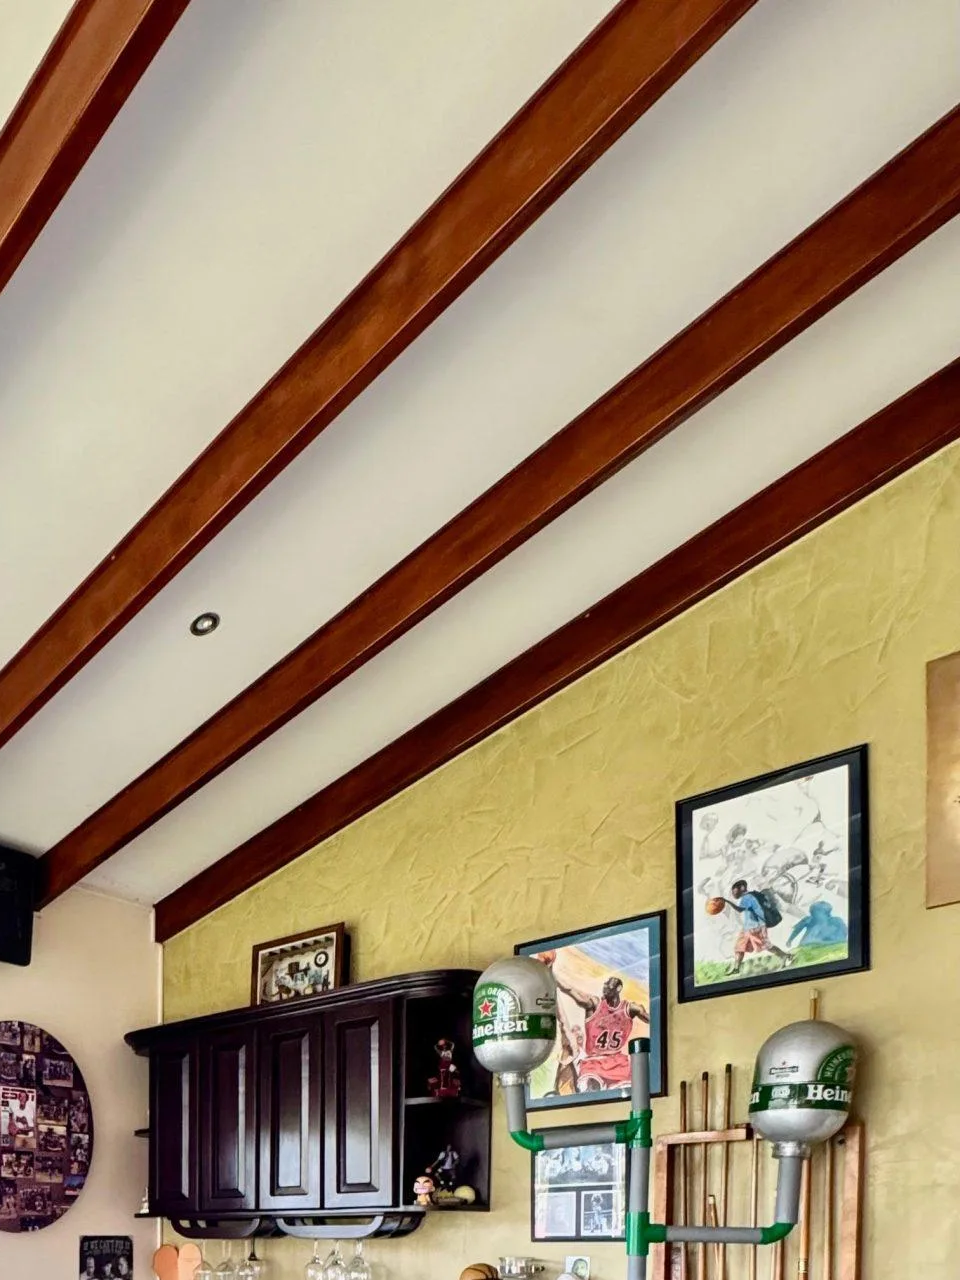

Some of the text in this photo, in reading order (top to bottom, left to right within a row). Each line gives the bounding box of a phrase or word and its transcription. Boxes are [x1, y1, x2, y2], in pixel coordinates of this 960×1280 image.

[472, 1018, 528, 1039] ineken
[596, 1030, 622, 1049] 45
[2, 1087, 35, 1101] ESN
